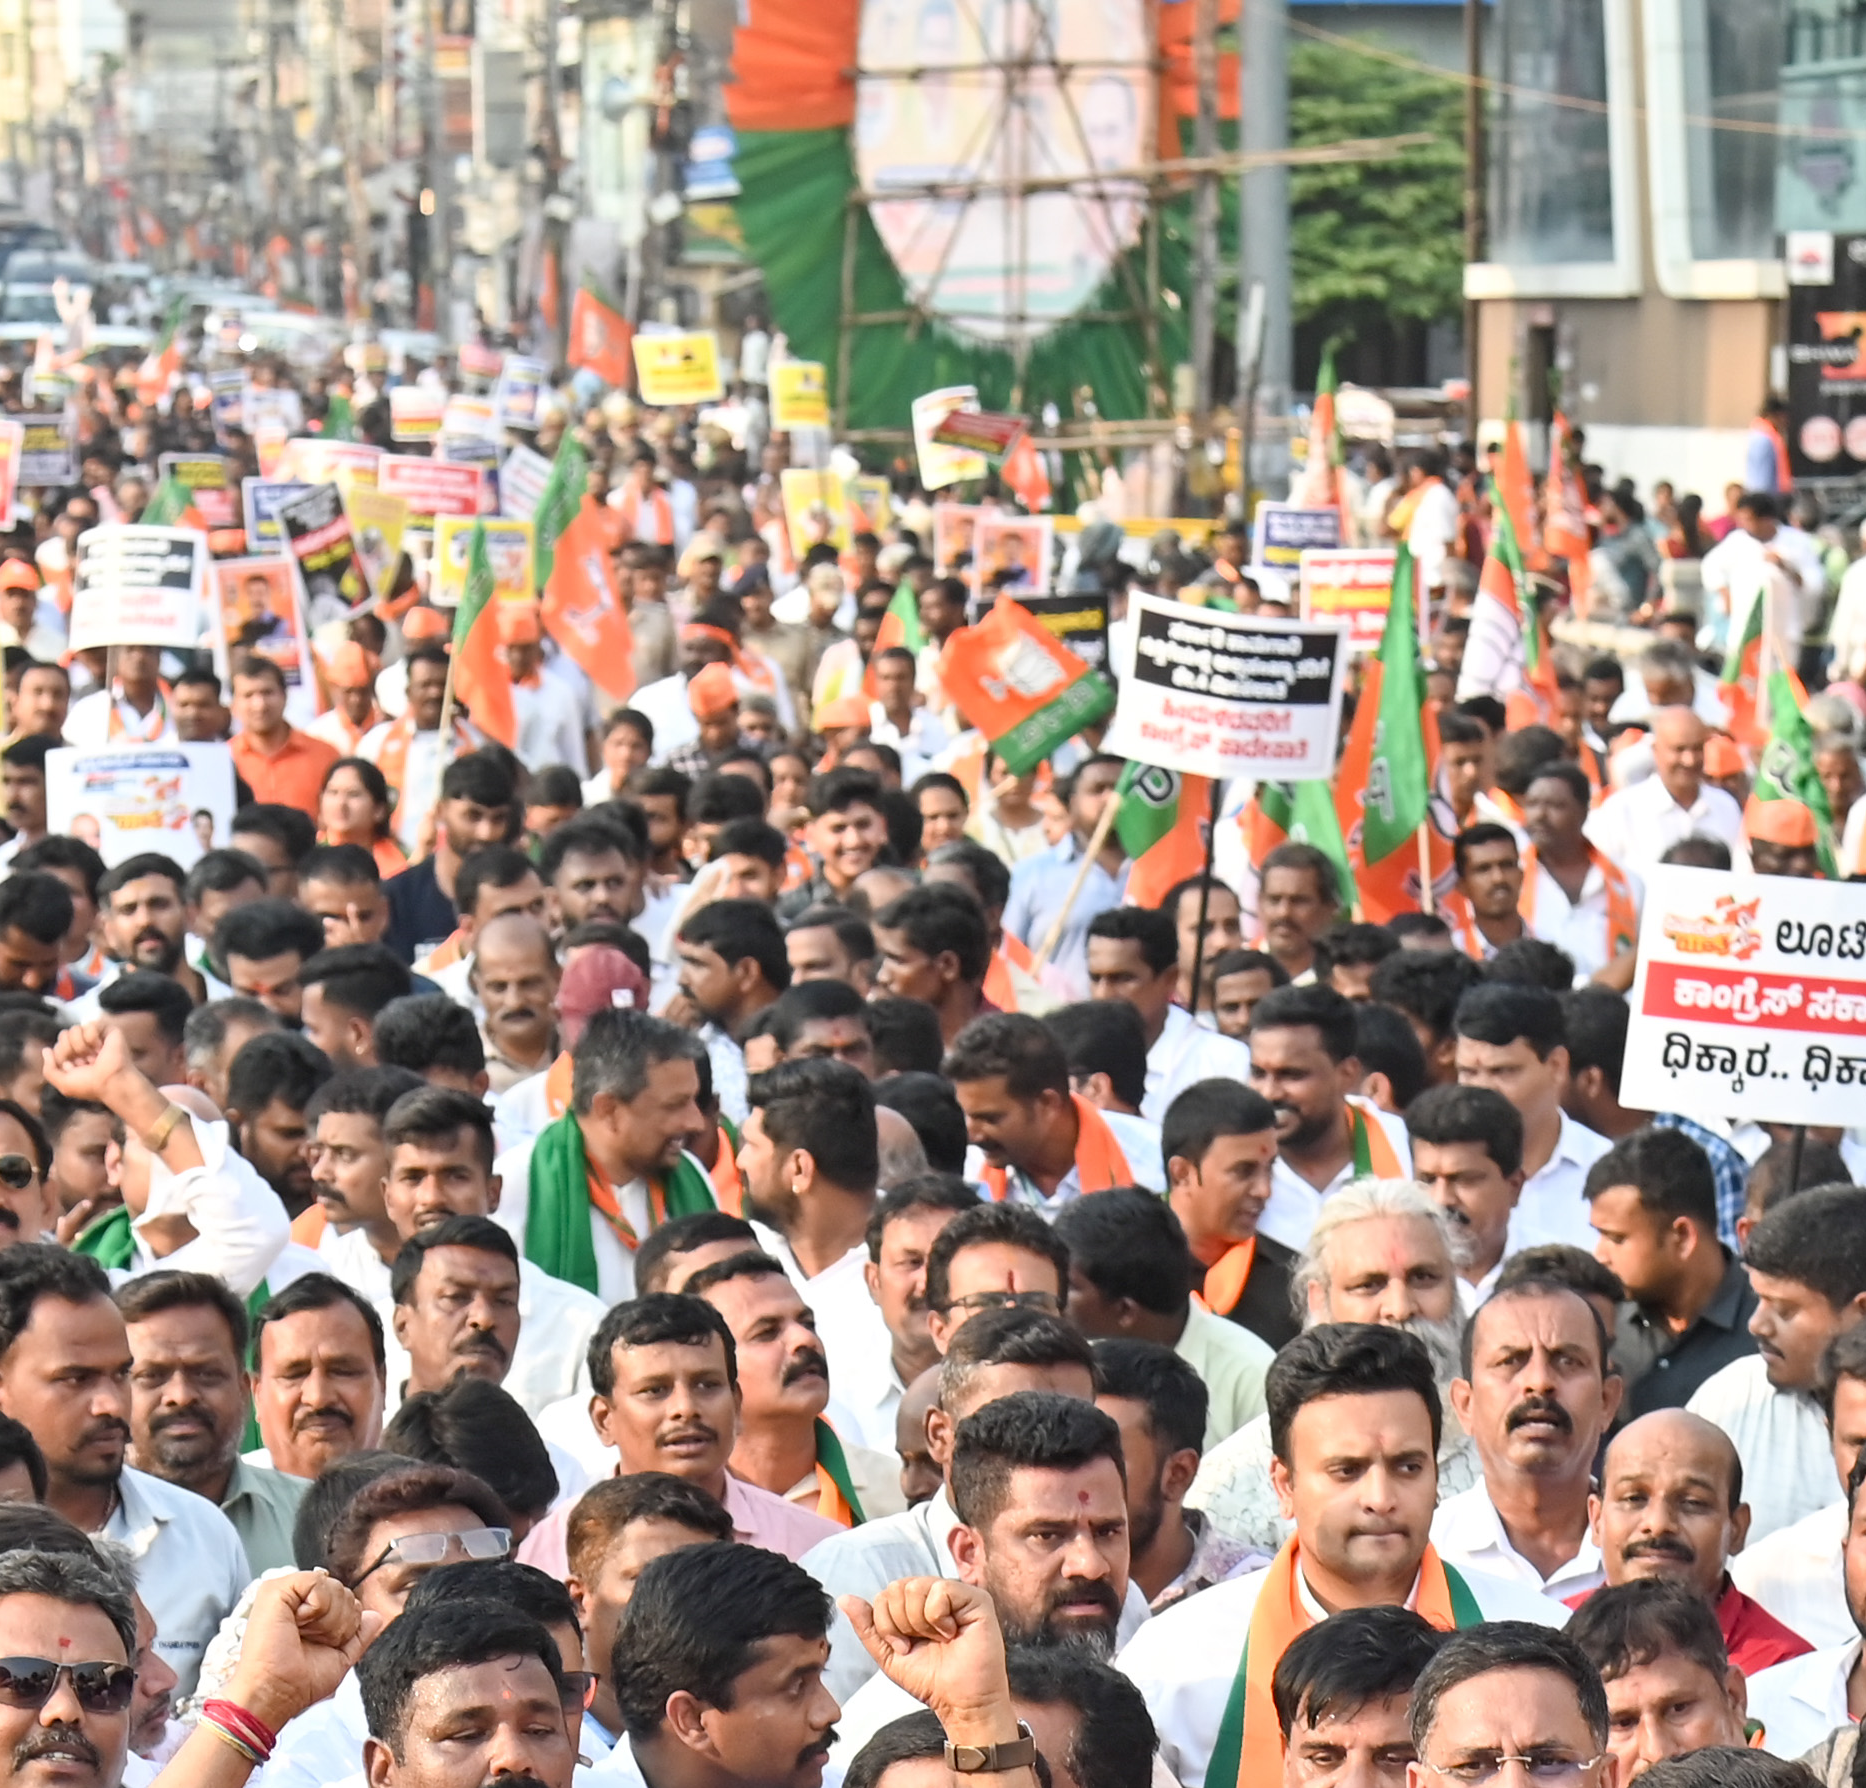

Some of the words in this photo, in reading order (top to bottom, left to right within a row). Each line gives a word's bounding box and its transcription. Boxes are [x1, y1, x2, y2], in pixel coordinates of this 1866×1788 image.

[1140, 720, 1212, 756] ಕಾಂಗ್ರೆಸ್
[1673, 977, 1804, 1023] ಕಾಂಗ್ರೆಸ್
[1662, 1031, 1789, 1094] ಧಿಕ್ಕಾರ..
